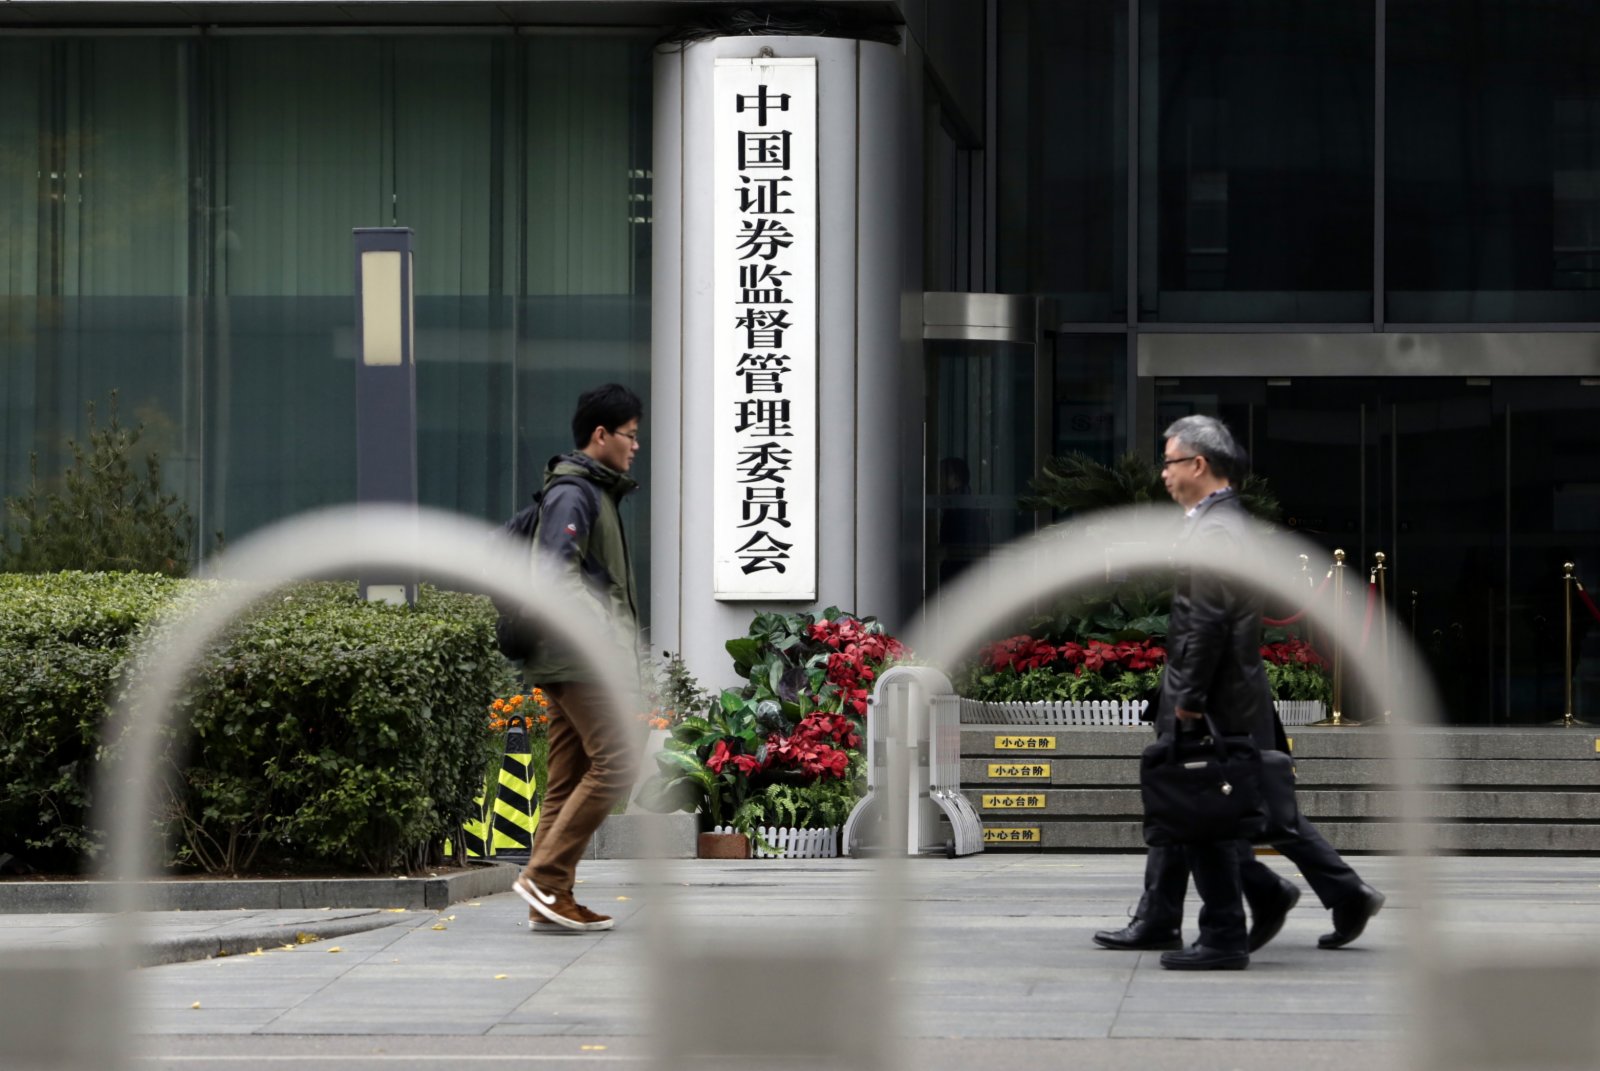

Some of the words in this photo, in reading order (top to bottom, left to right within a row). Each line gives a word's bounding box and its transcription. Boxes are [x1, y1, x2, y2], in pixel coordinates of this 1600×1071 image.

[734, 84, 795, 575] 中国证券监督管理委员会
[1001, 737, 1050, 748] 小心台阶
[995, 765, 1044, 776] 小心台阶
[989, 796, 1039, 807] 小心台阶
[984, 829, 1034, 840] 小心台阶
